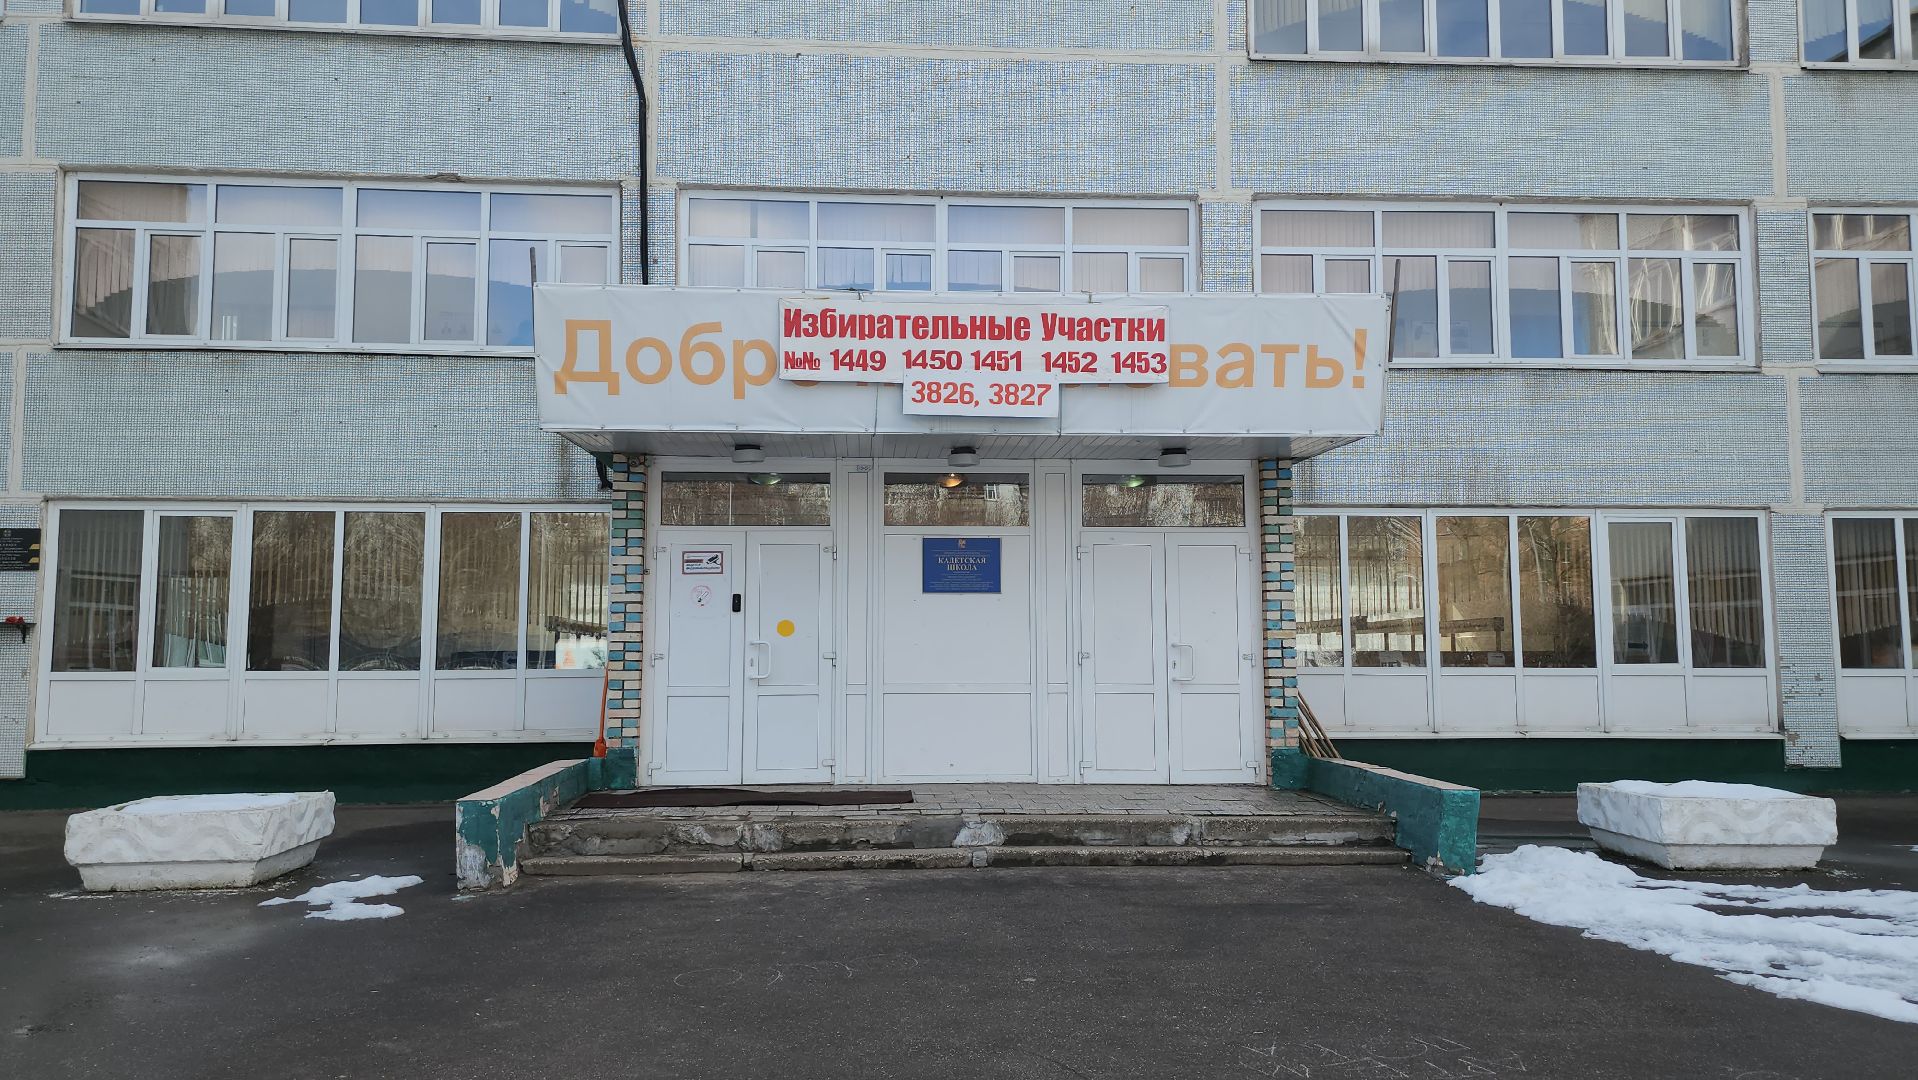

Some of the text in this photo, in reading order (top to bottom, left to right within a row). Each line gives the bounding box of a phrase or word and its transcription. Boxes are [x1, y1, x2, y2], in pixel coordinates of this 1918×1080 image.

[784, 308, 1165, 342] Избирательные Участки
[554, 320, 823, 400] Добр
[831, 349, 887, 372] 1449
[902, 349, 963, 371] 1450
[971, 350, 1022, 372] 1451
[1041, 351, 1098, 374] 1452
[1111, 351, 1167, 374] 1453
[911, 381, 1052, 408] 3826, 3827
